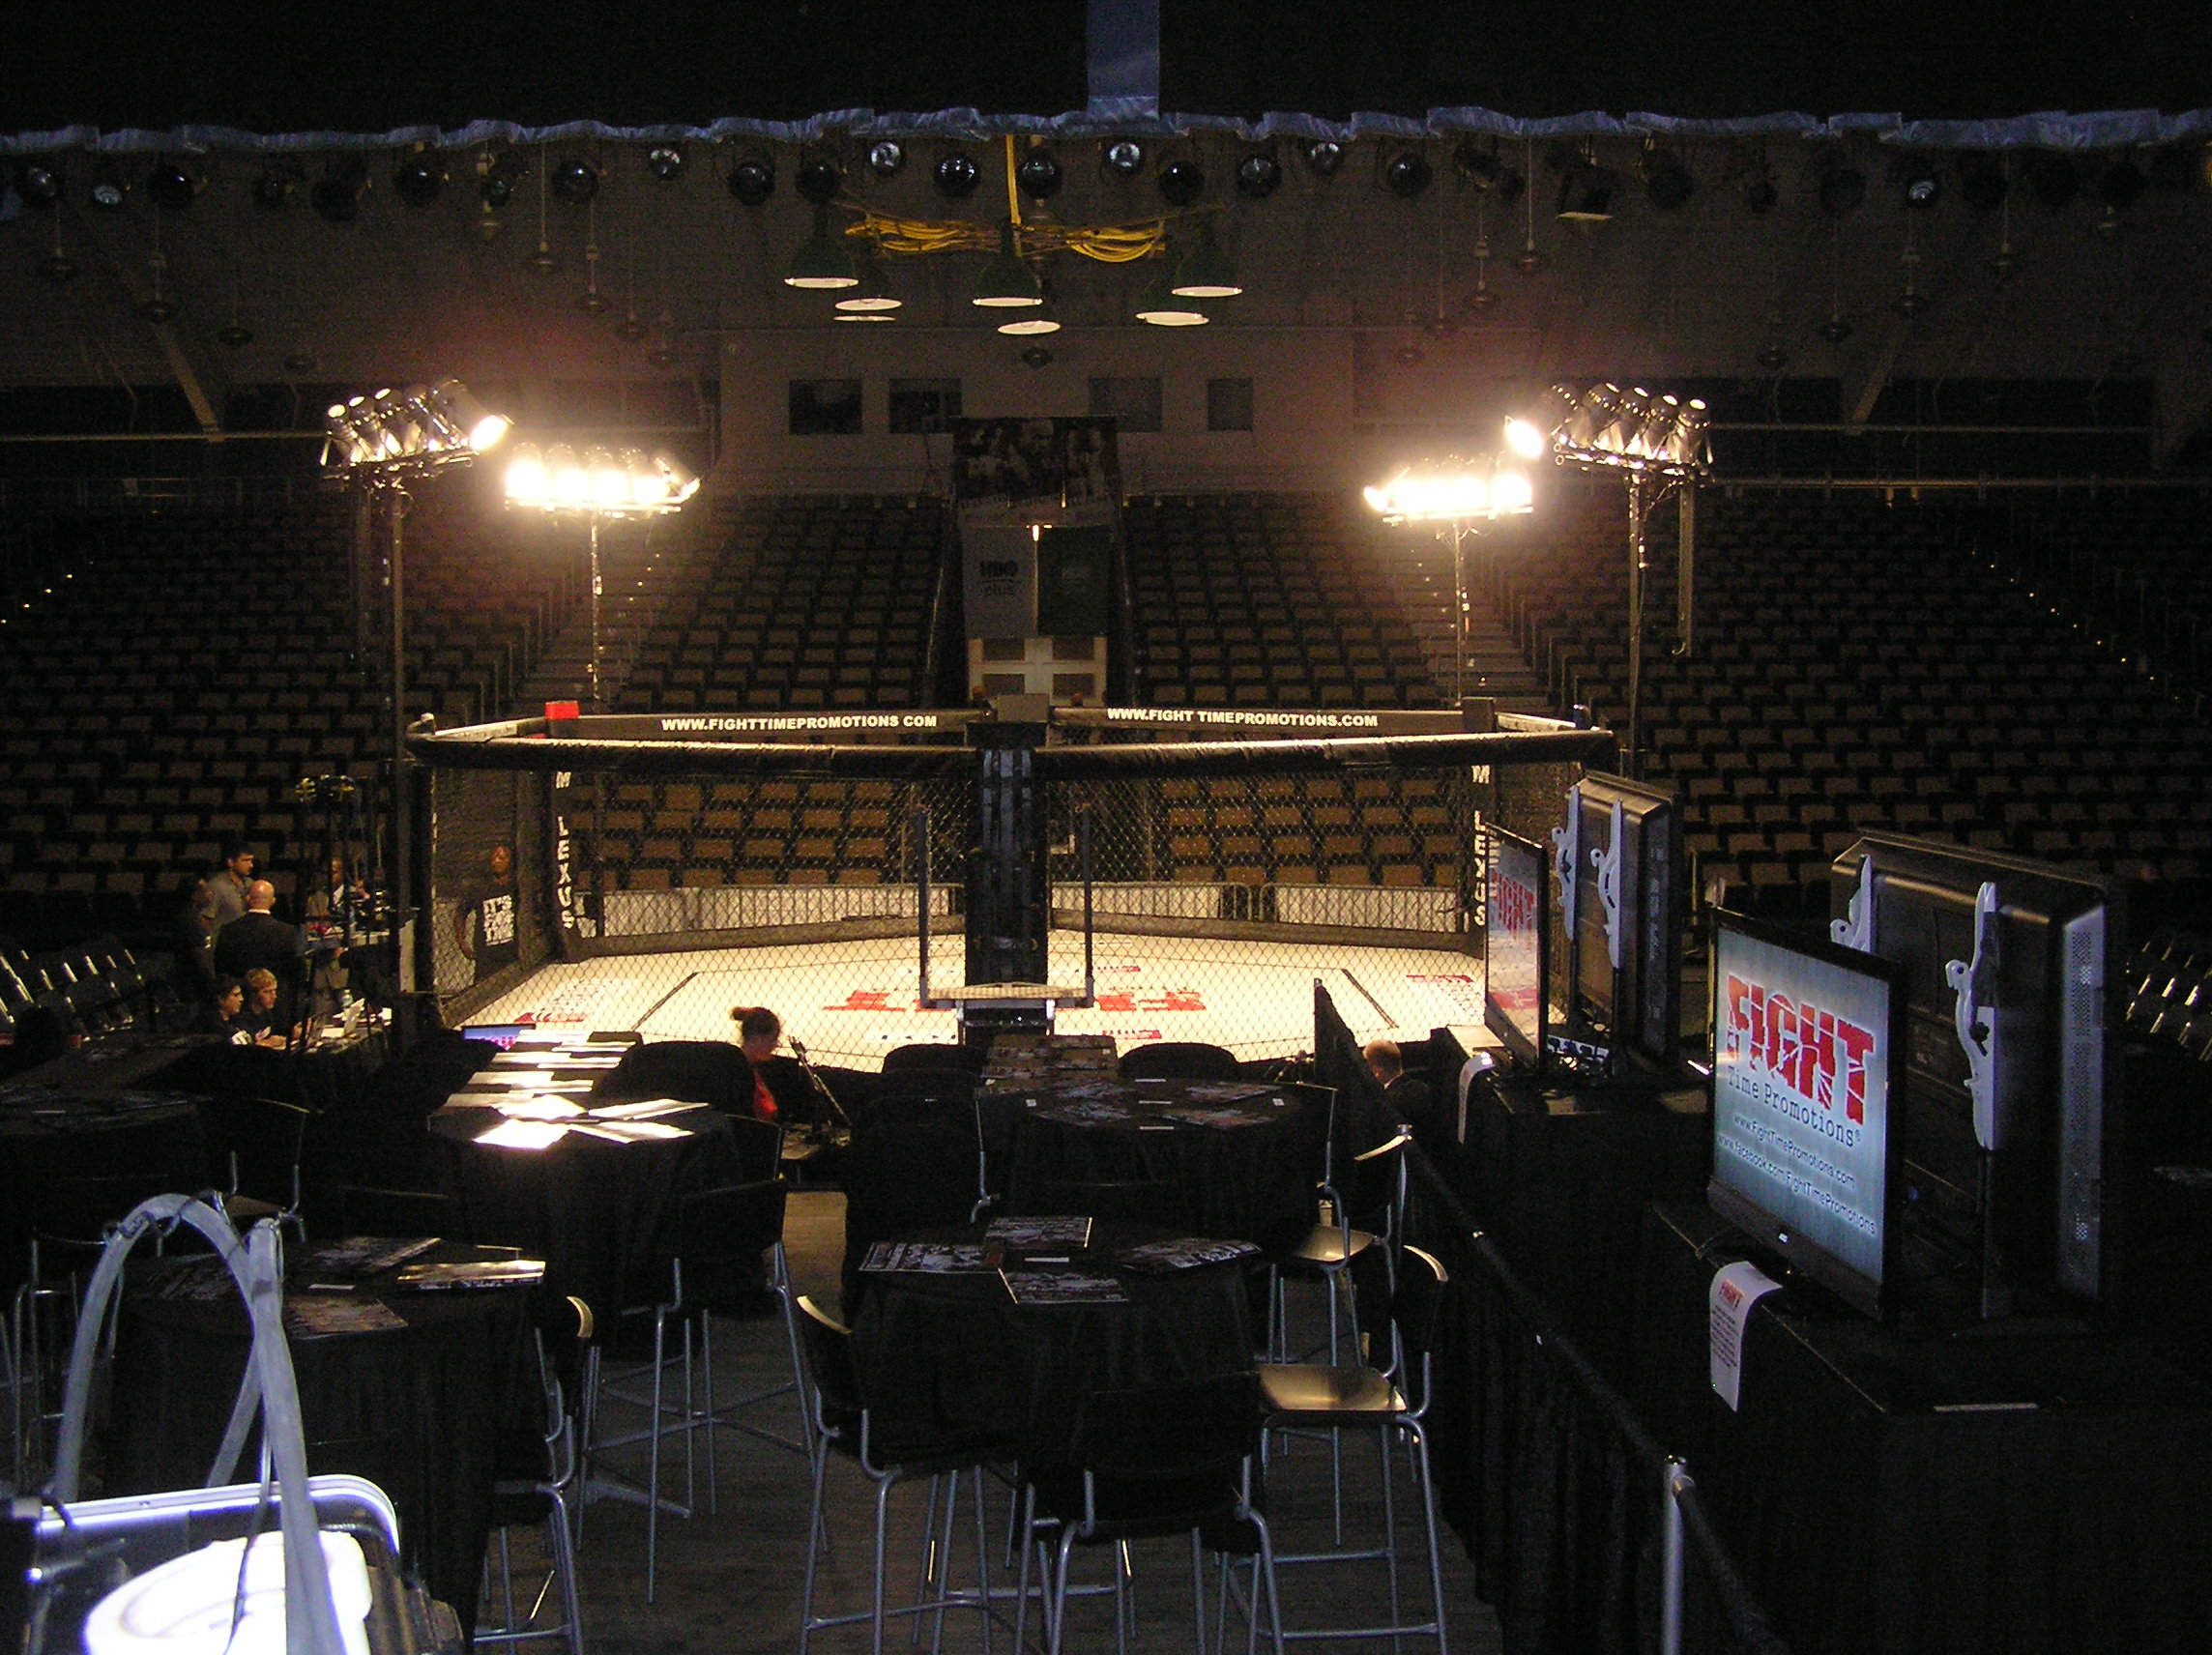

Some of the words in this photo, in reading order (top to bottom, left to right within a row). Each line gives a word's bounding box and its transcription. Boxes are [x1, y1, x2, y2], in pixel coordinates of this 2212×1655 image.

[1197, 711, 1379, 727] TIMEPROMOTIONS.COM
[557, 816, 575, 929] LEXUS
[1474, 810, 1487, 929] LEXUS
[1727, 973, 1875, 1127] FIGHT
[1728, 1064, 1759, 1100] Time
